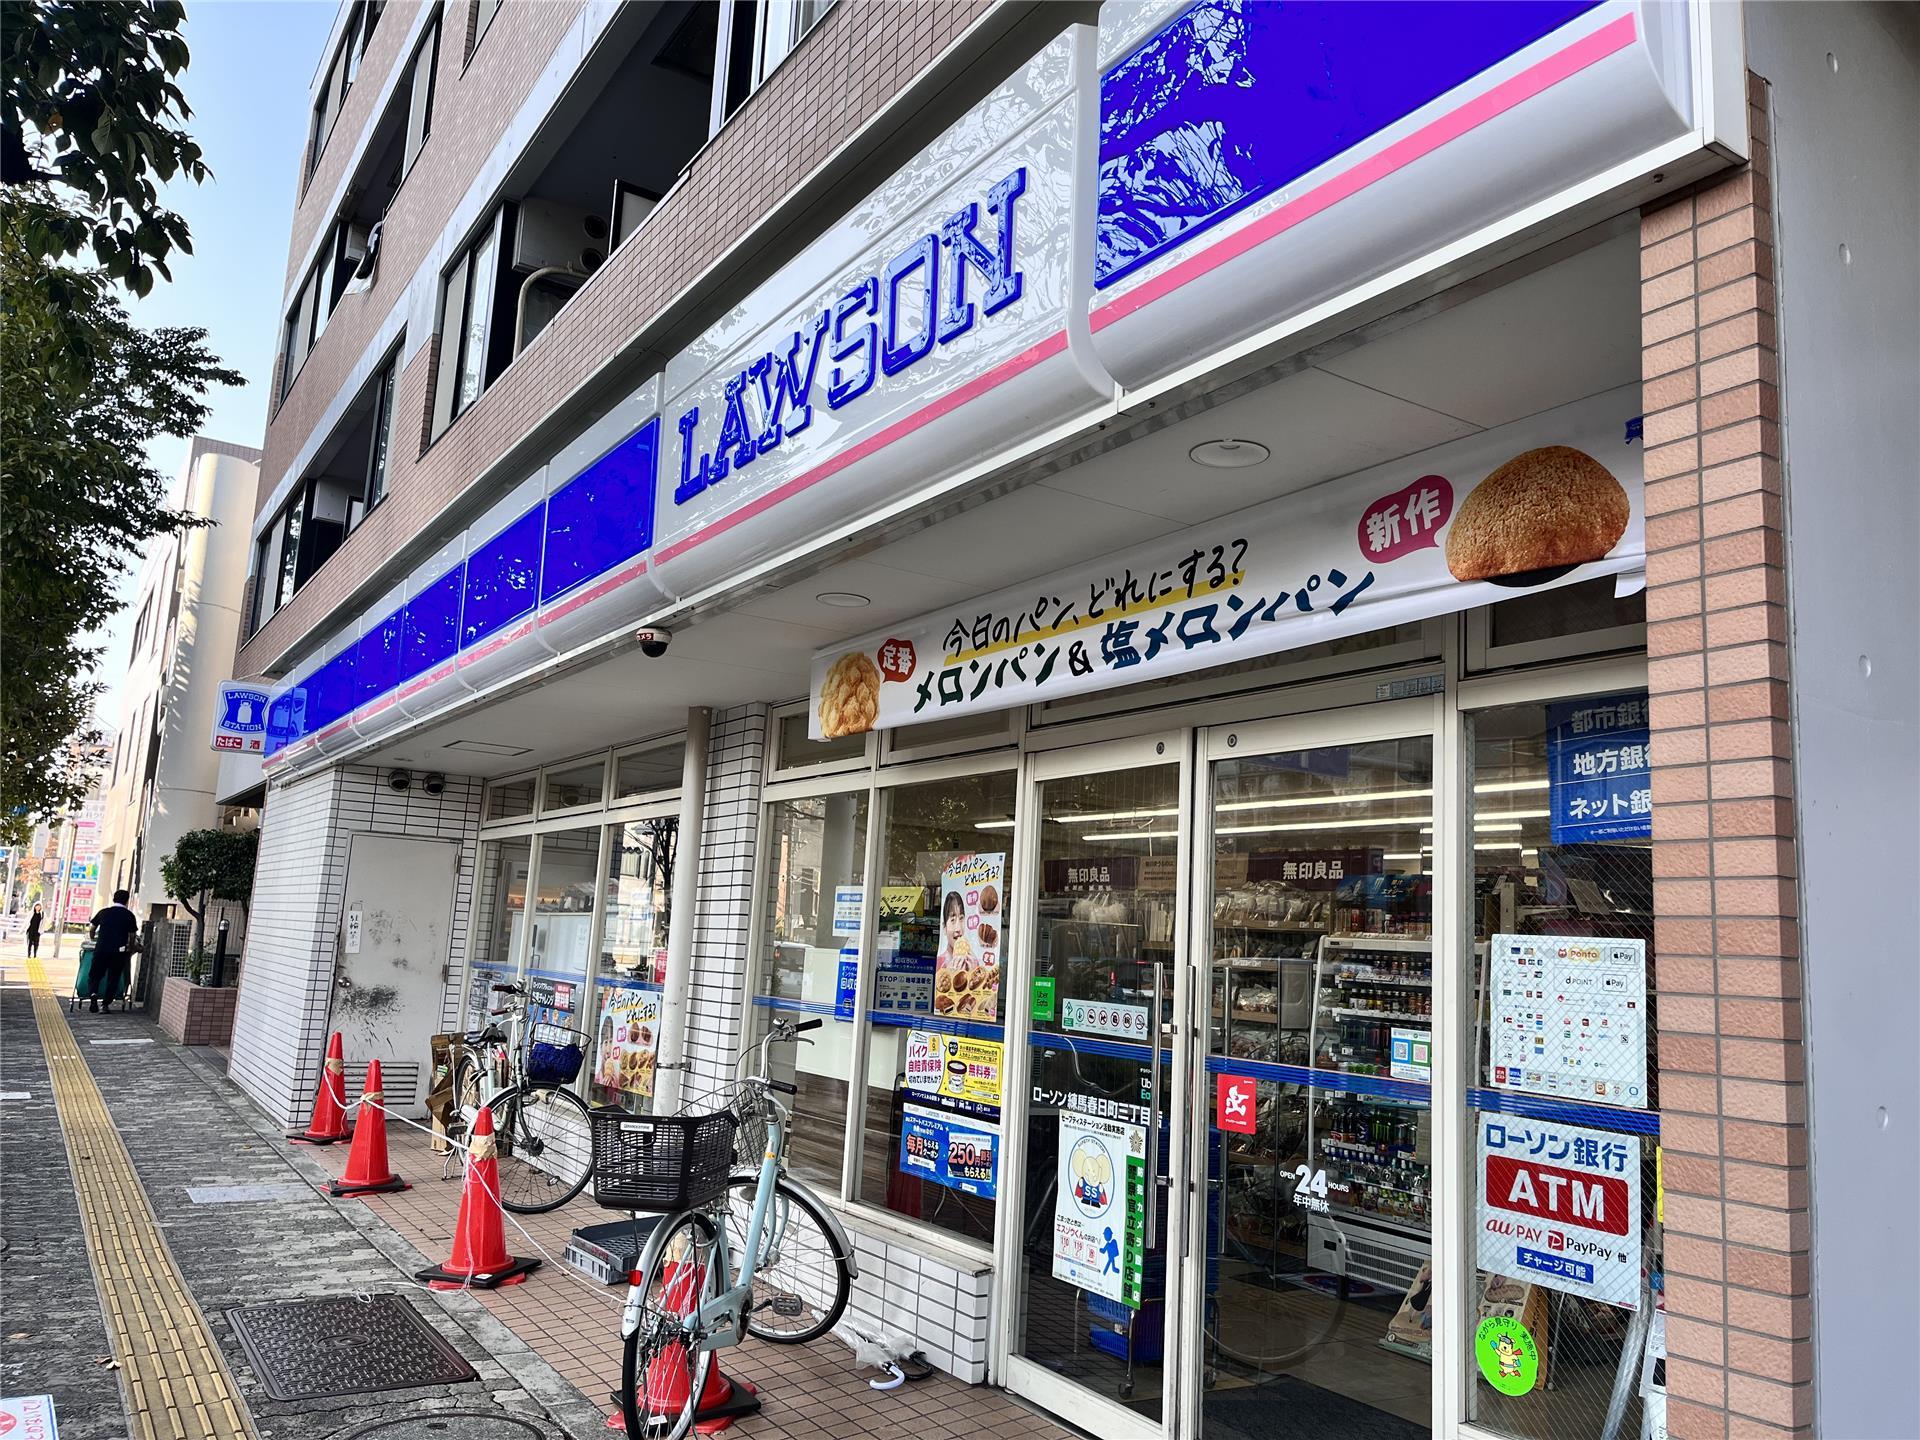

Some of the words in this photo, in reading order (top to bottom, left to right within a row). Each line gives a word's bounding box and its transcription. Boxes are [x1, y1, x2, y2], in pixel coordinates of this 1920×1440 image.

[674, 167, 1026, 505] LAWSON
[1366, 488, 1441, 552] 新作
[882, 645, 914, 675] 定番
[228, 692, 266, 703] LAWSON
[224, 720, 261, 731] STATION
[216, 737, 241, 748] たばこ
[1068, 866, 1110, 883] 無印良品
[1283, 860, 1344, 880] 無印良品
[1570, 949, 1599, 960] Ponta
[1619, 952, 1633, 961] Pay
[1612, 980, 1624, 988] Pay
[1036, 998, 1049, 1007] Eats
[909, 1044, 928, 1058] バイク
[908, 1059, 942, 1073] 自賠責保険
[907, 1134, 923, 1156] 毎月
[923, 1138, 939, 1150] もらえる
[1486, 1123, 1628, 1173] ローソン銀行
[1084, 1184, 1098, 1199] SS
[1279, 1170, 1295, 1180] OPEN
[1295, 1164, 1328, 1199] 24
[1328, 1181, 1349, 1193] HOURS
[1293, 1193, 1330, 1214] 年中無休
[1508, 1169, 1604, 1223] ATM
[1486, 1219, 1516, 1236] au
[1516, 1224, 1542, 1243] PAY
[1566, 1237, 1612, 1261] PayPay
[1617, 1252, 1628, 1264] 他
[1523, 1252, 1587, 1279] チャージ可能
[1478, 1317, 1517, 1341] ながら見守り
[1520, 1331, 1536, 1361] 実施中
